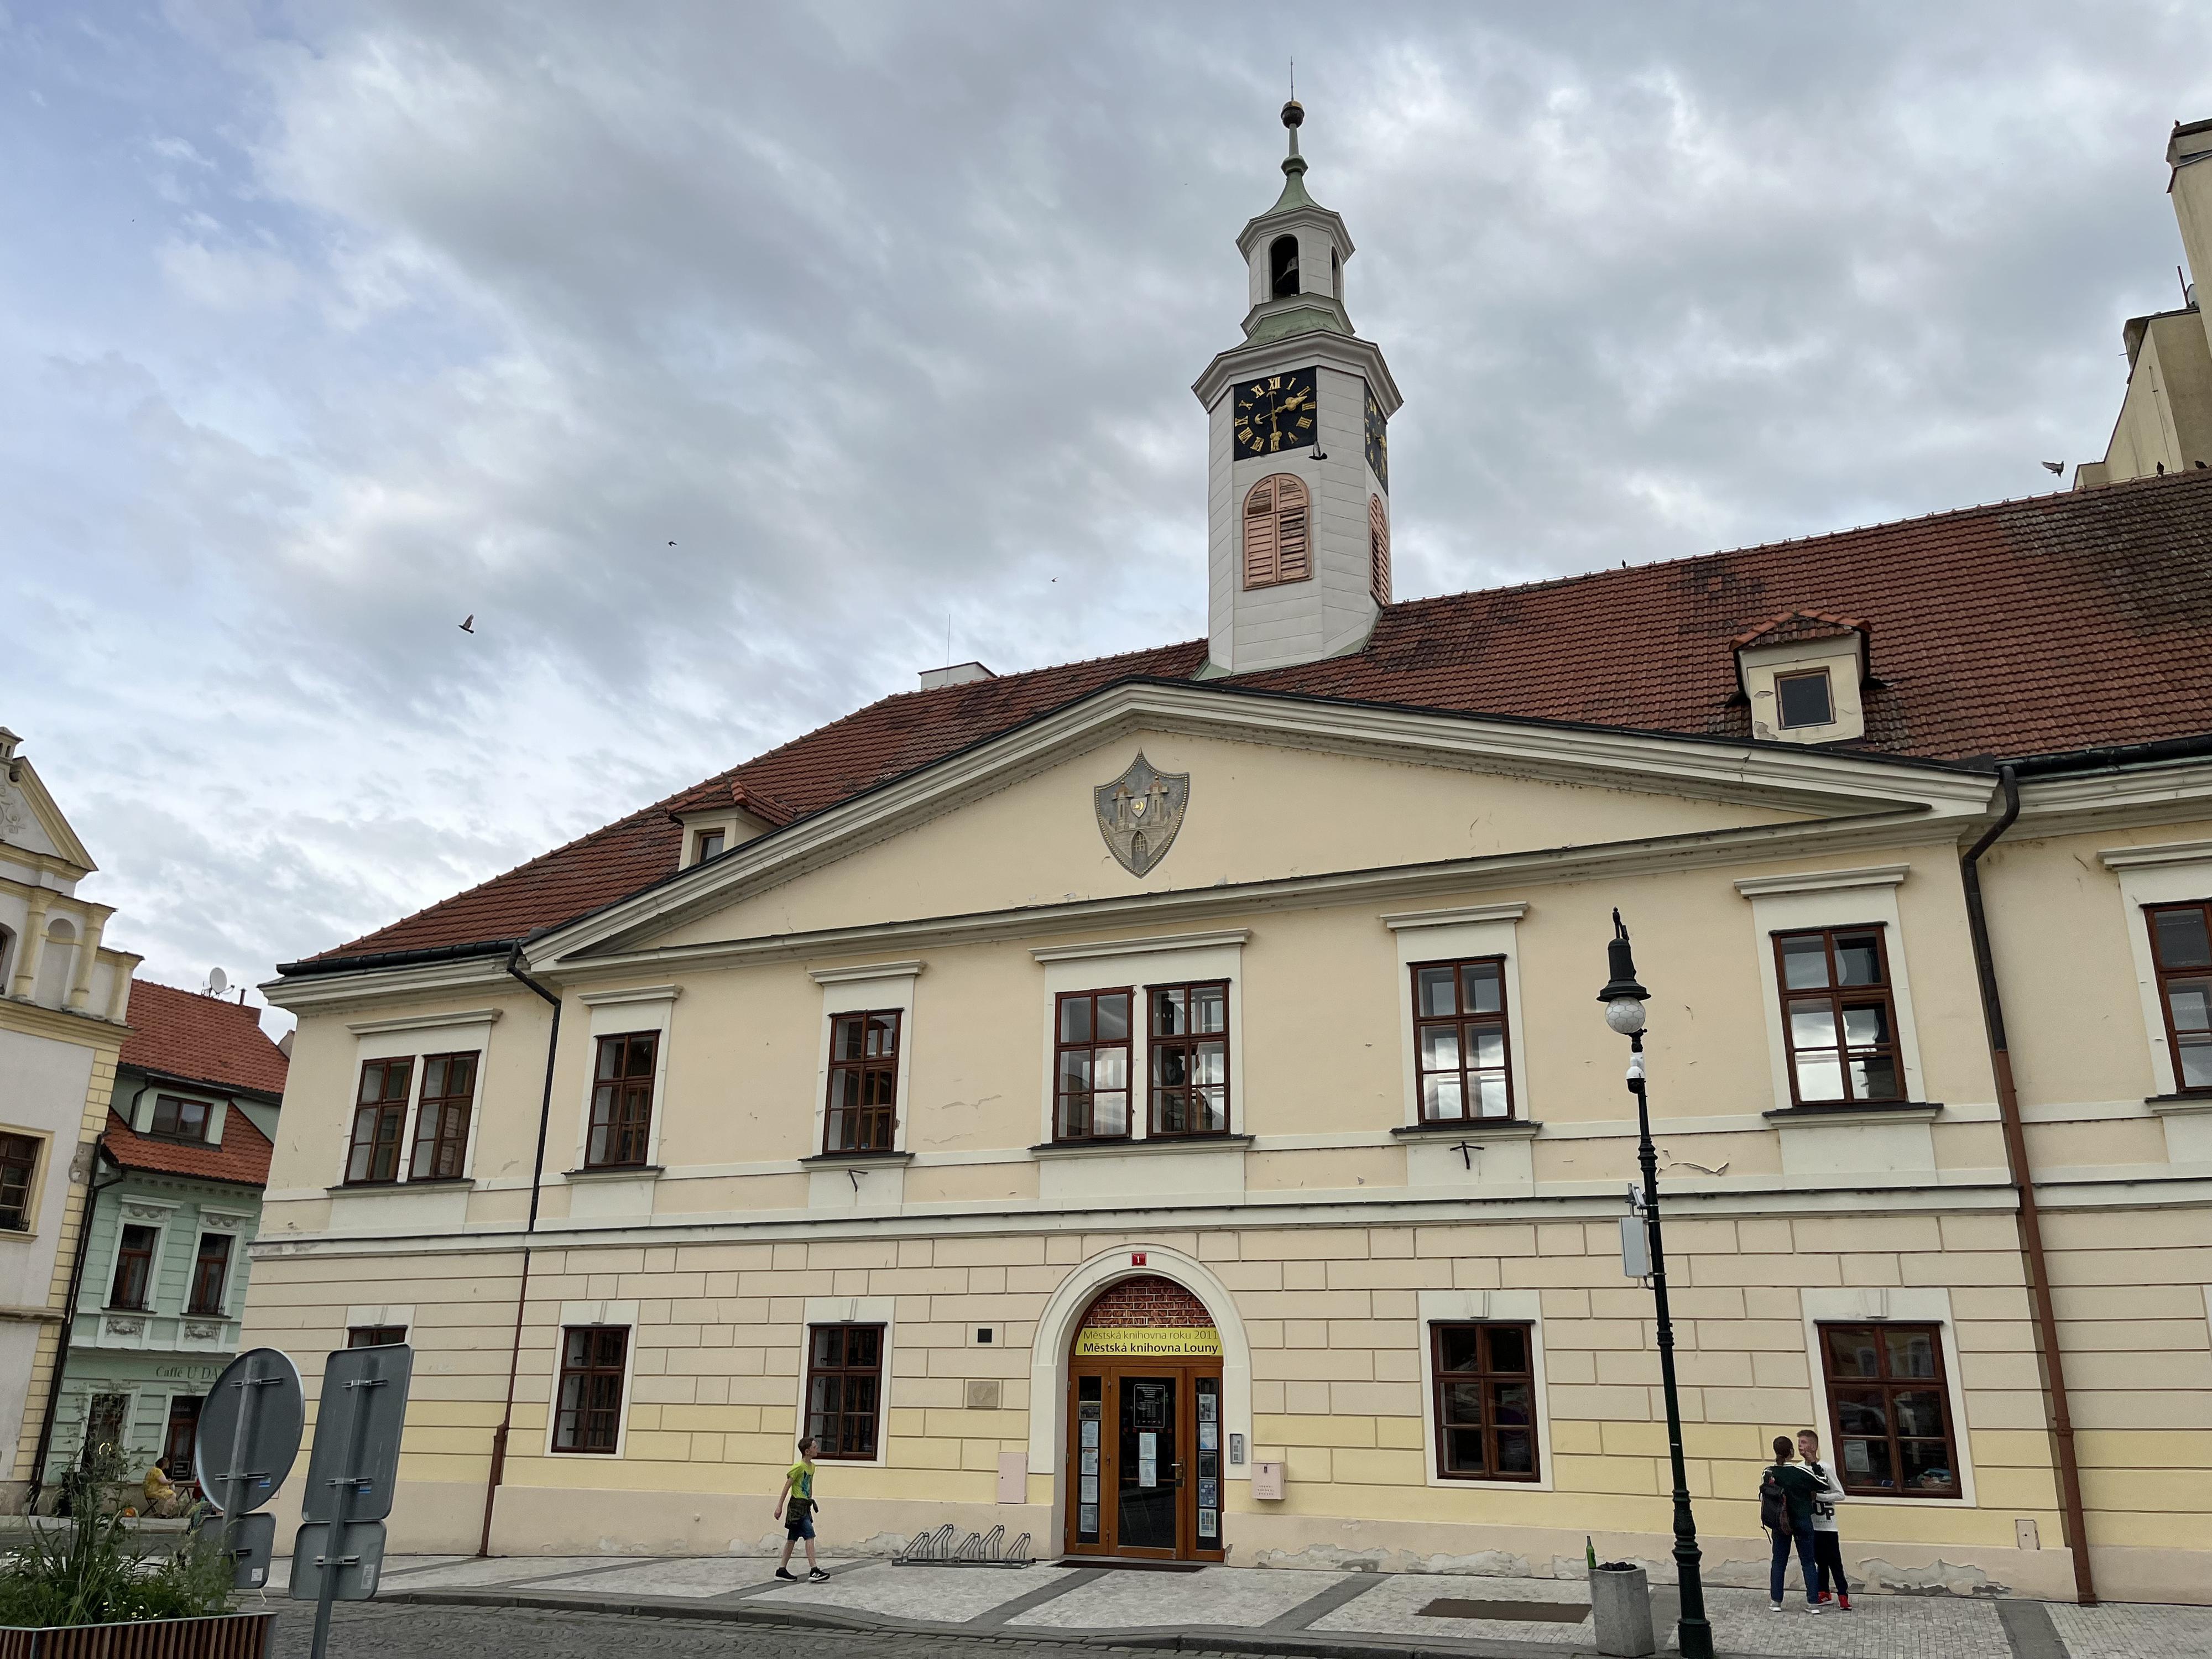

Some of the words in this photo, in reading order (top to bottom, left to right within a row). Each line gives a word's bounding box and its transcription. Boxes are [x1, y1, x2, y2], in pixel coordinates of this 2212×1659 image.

[1267, 376, 1281, 390] XII
[1286, 377, 1296, 390] I
[1238, 400, 1253, 410] X
[1083, 1331, 1121, 1339] Městská
[1124, 1331, 1167, 1339] knihovna
[1170, 1331, 1191, 1339] roku
[1194, 1330, 1218, 1339] 2011
[1083, 1343, 1127, 1353] Městská
[1130, 1343, 1181, 1353] knihovna
[1185, 1343, 1218, 1354] Louny
[187, 1366, 197, 1379] U
